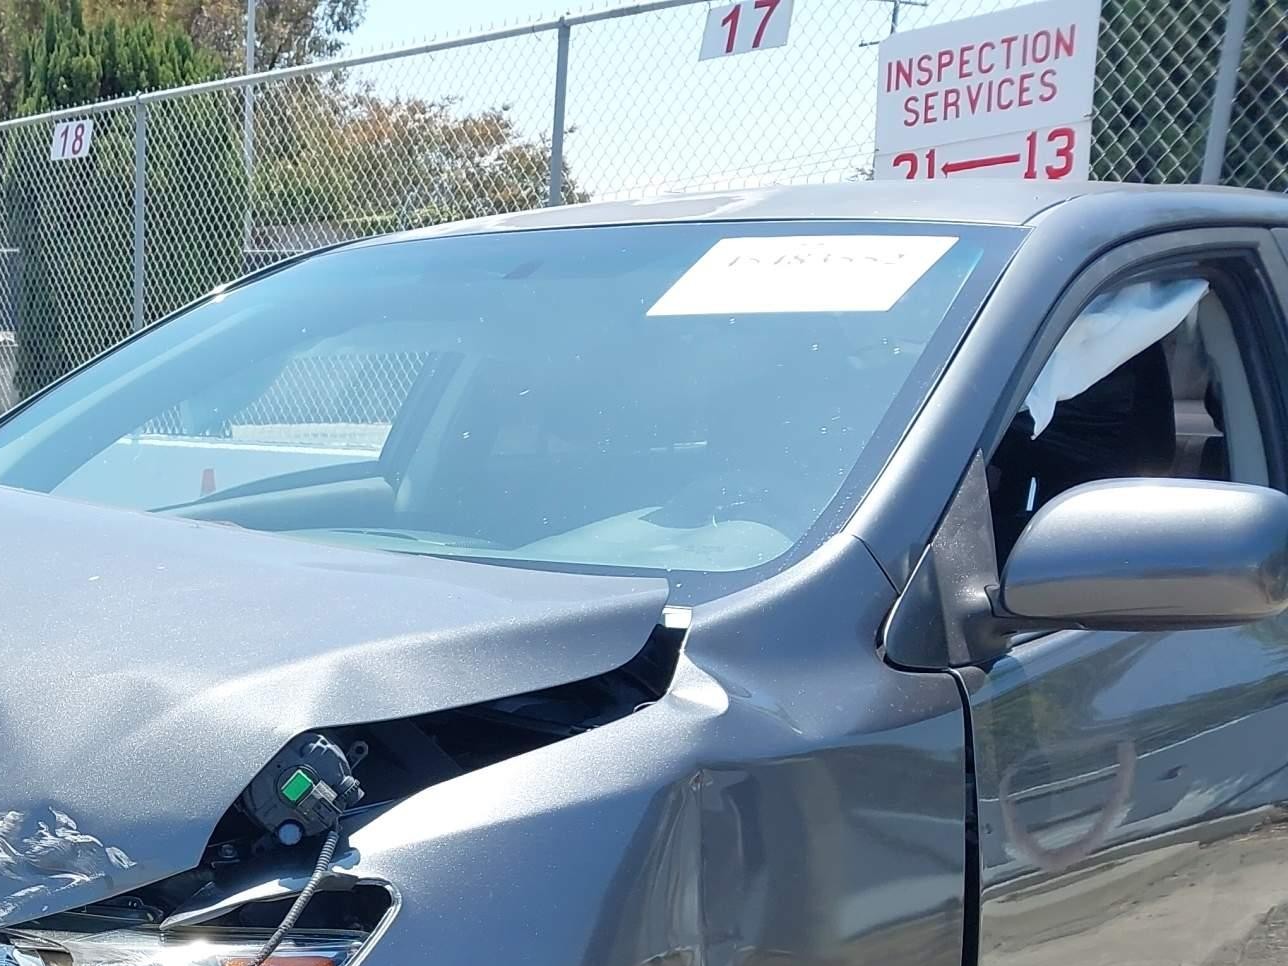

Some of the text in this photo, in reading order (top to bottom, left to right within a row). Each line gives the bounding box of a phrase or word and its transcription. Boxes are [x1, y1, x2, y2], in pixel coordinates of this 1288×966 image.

[720, 0, 781, 54] 17
[886, 24, 1076, 93] INSPECTION
[903, 69, 1058, 127] SERVICES
[60, 123, 85, 157] 18
[1023, 127, 1076, 180] 13
